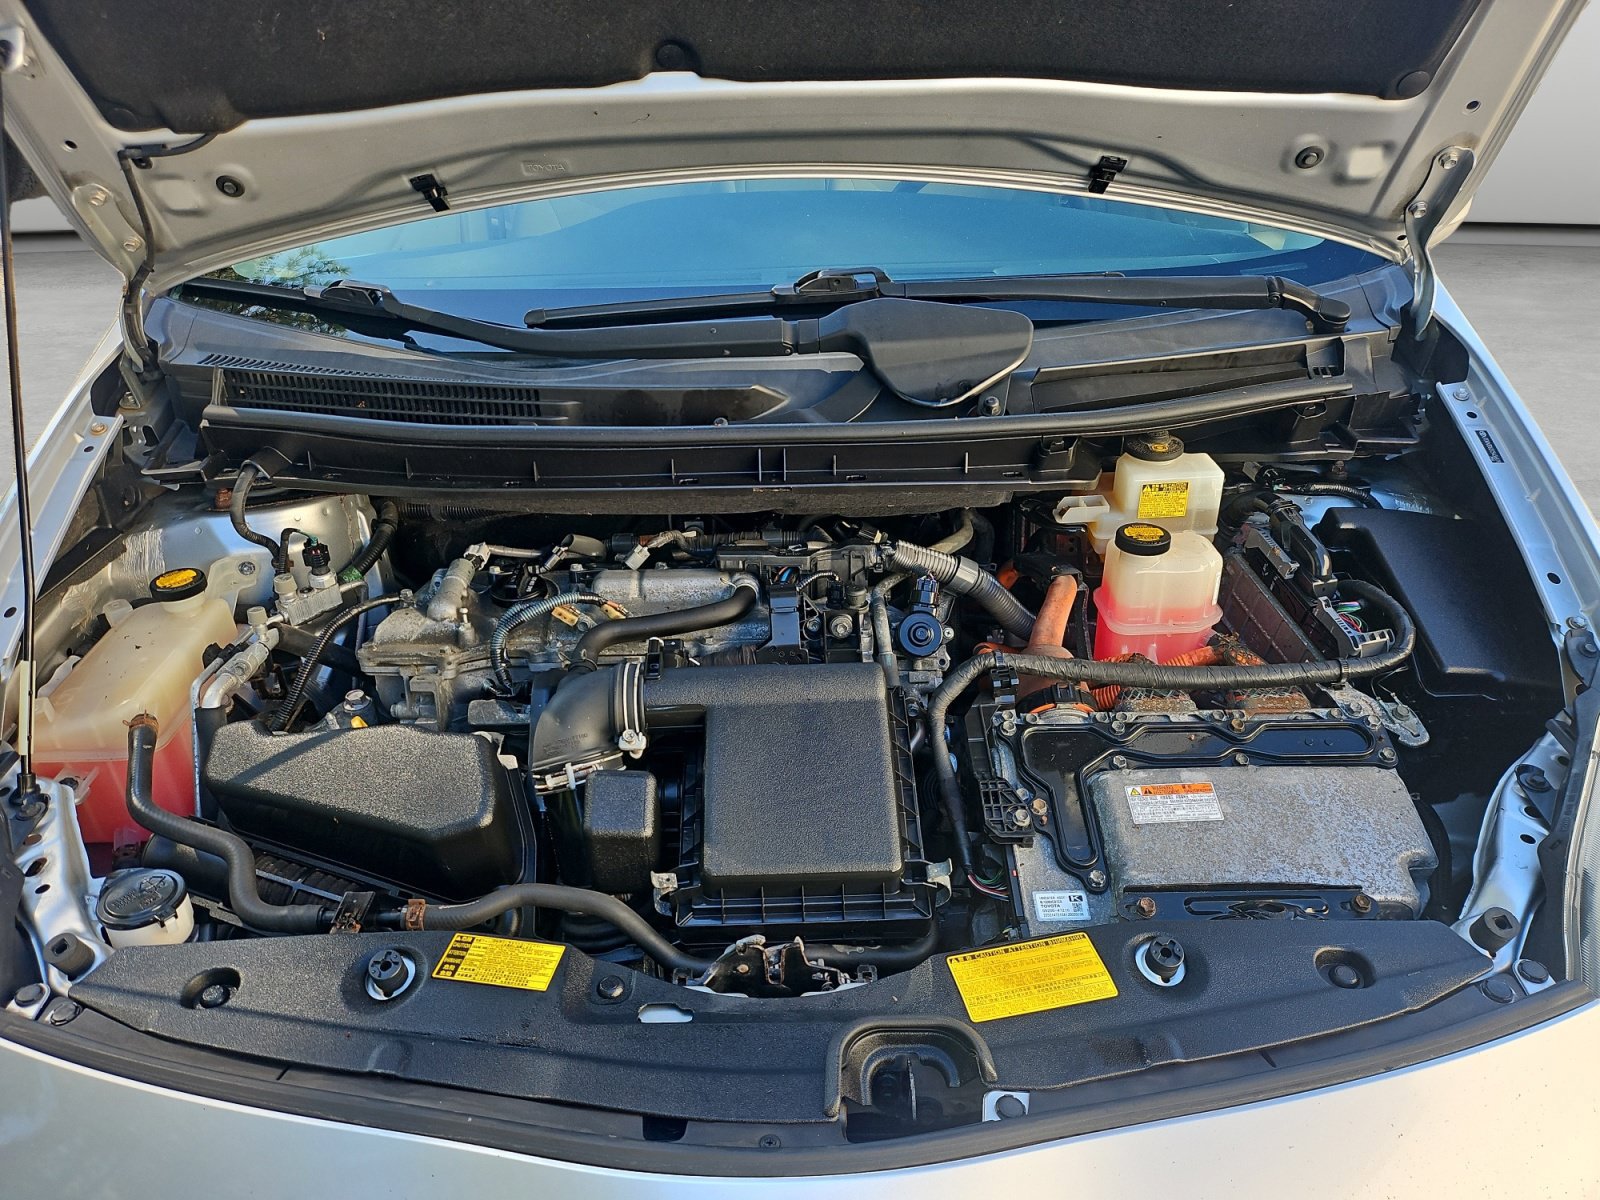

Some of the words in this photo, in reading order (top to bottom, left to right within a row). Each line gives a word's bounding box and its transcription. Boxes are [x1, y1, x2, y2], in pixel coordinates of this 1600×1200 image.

[527, 163, 566, 172] TOYOTA
[974, 948, 1005, 960] CAUTION
[1008, 941, 1046, 954] ATTENTION
